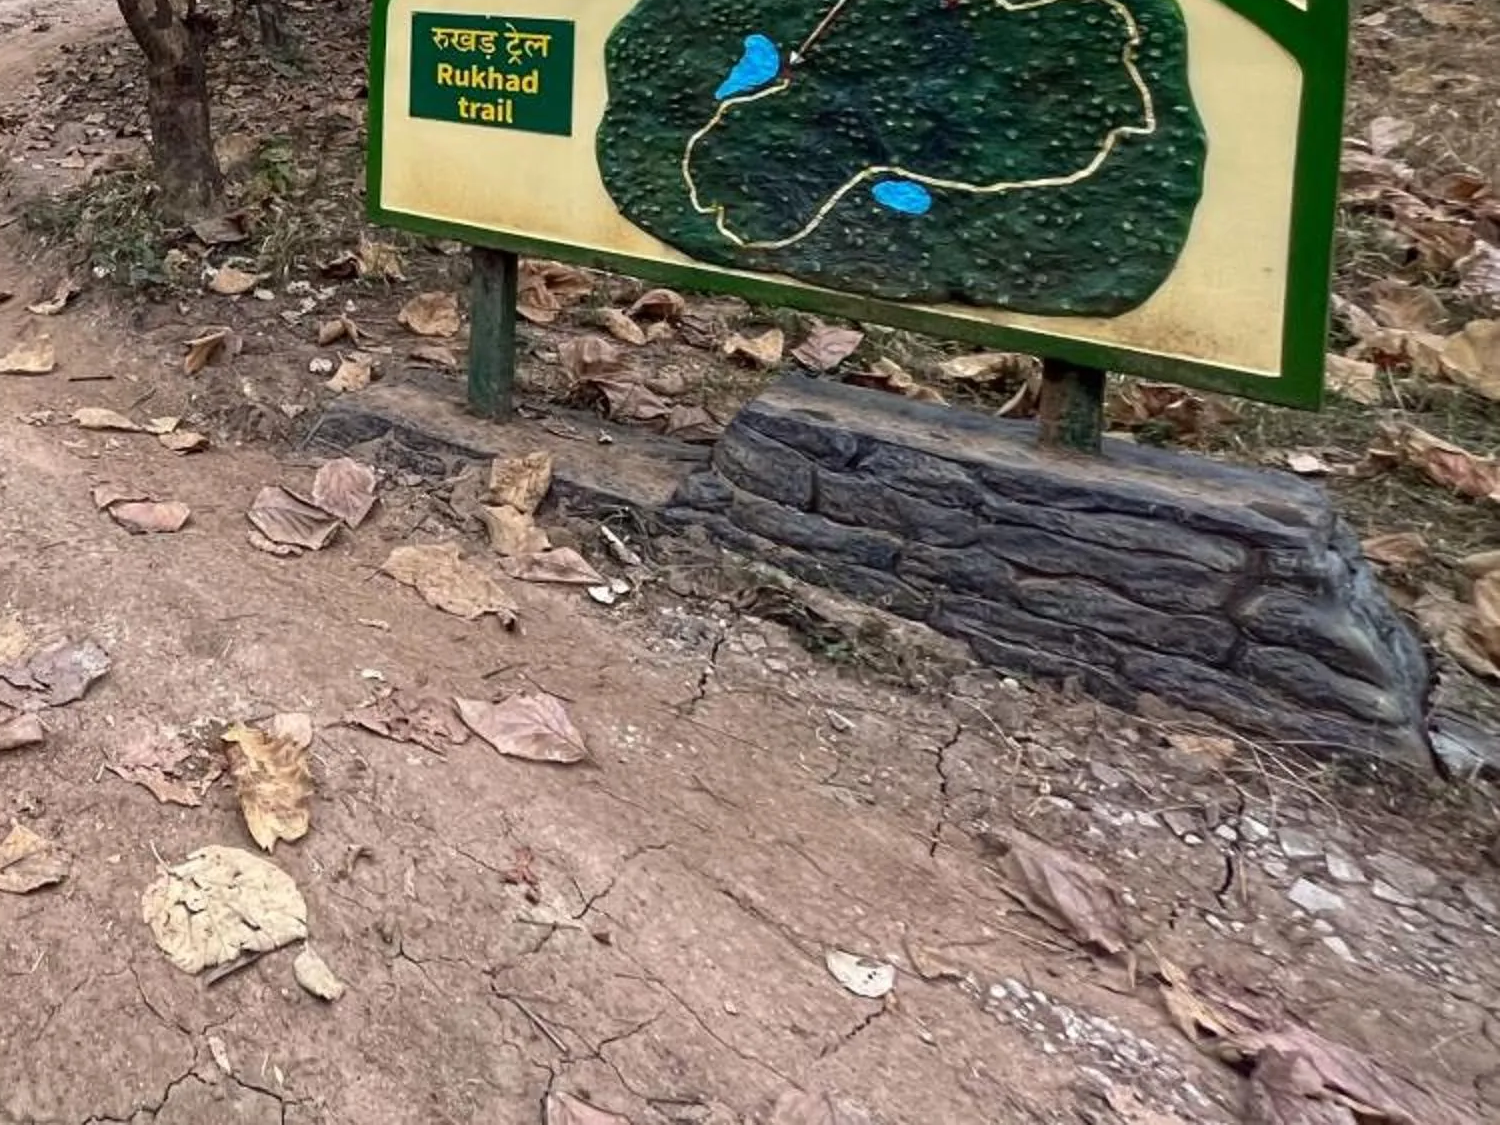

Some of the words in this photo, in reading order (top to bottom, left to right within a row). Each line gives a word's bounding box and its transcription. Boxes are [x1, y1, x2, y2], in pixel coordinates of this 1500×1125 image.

[432, 27, 498, 59] रुखड़
[503, 22, 552, 65] ट्रेल
[437, 63, 538, 94] Rukhad
[458, 97, 513, 124] trail
